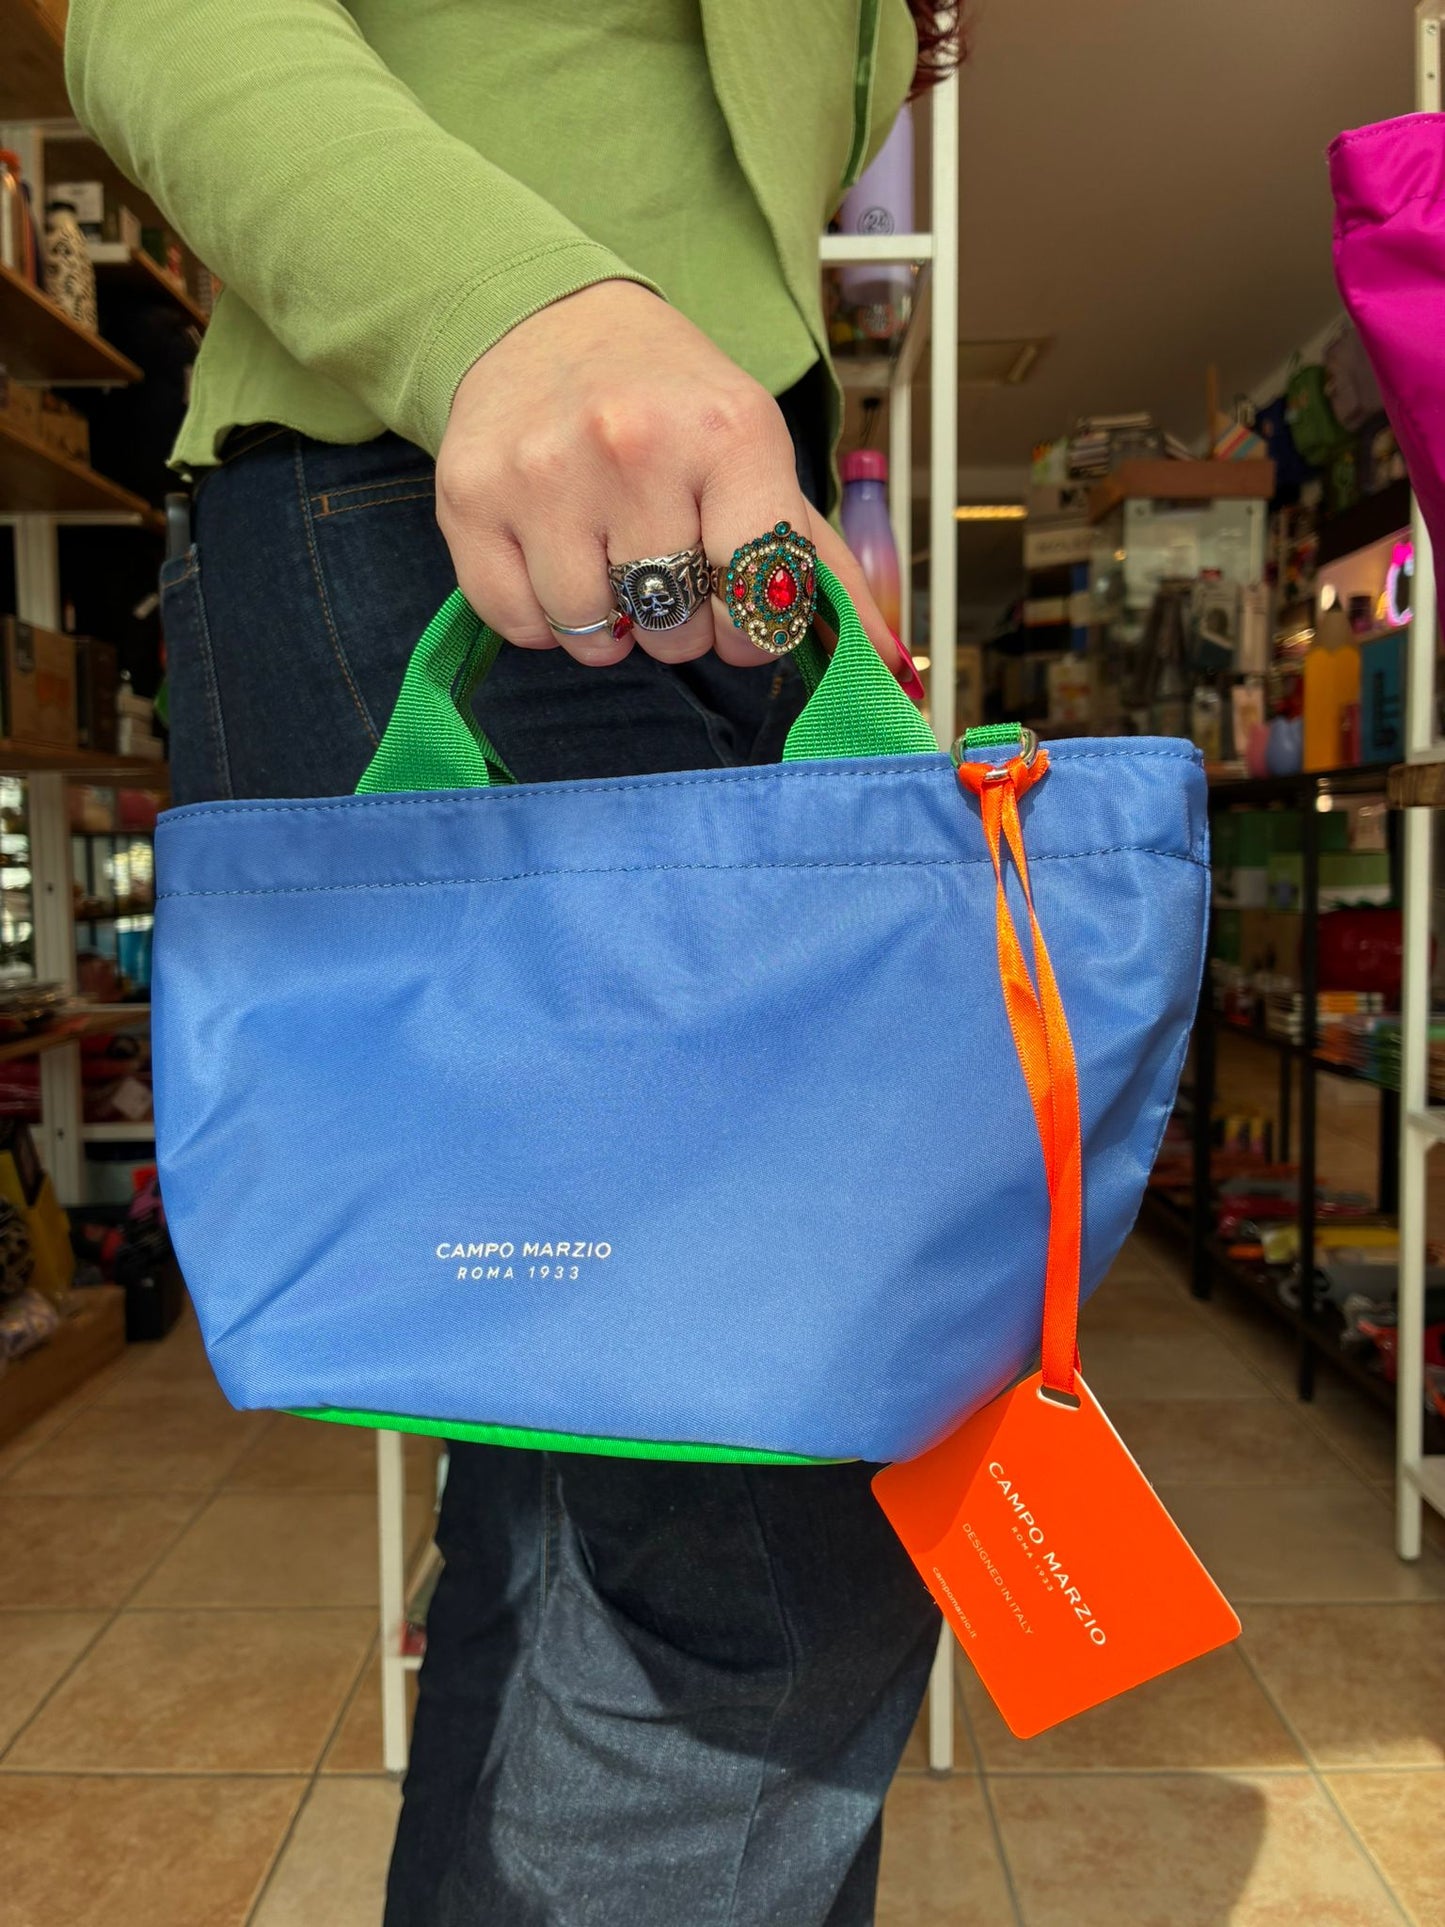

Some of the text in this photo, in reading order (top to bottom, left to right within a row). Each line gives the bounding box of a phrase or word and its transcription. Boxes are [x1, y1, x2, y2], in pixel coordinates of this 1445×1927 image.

[436, 1242, 612, 1259] CAMPO MARZIO
[457, 1266, 579, 1280] ROMA 1933
[962, 1523, 1033, 1634] DESIGNED IN ITALY
[989, 1462, 1106, 1645] CAMPO MARZIO
[1011, 1526, 1054, 1591] ROMA 1933
[932, 1567, 977, 1638] campomarzio.it
